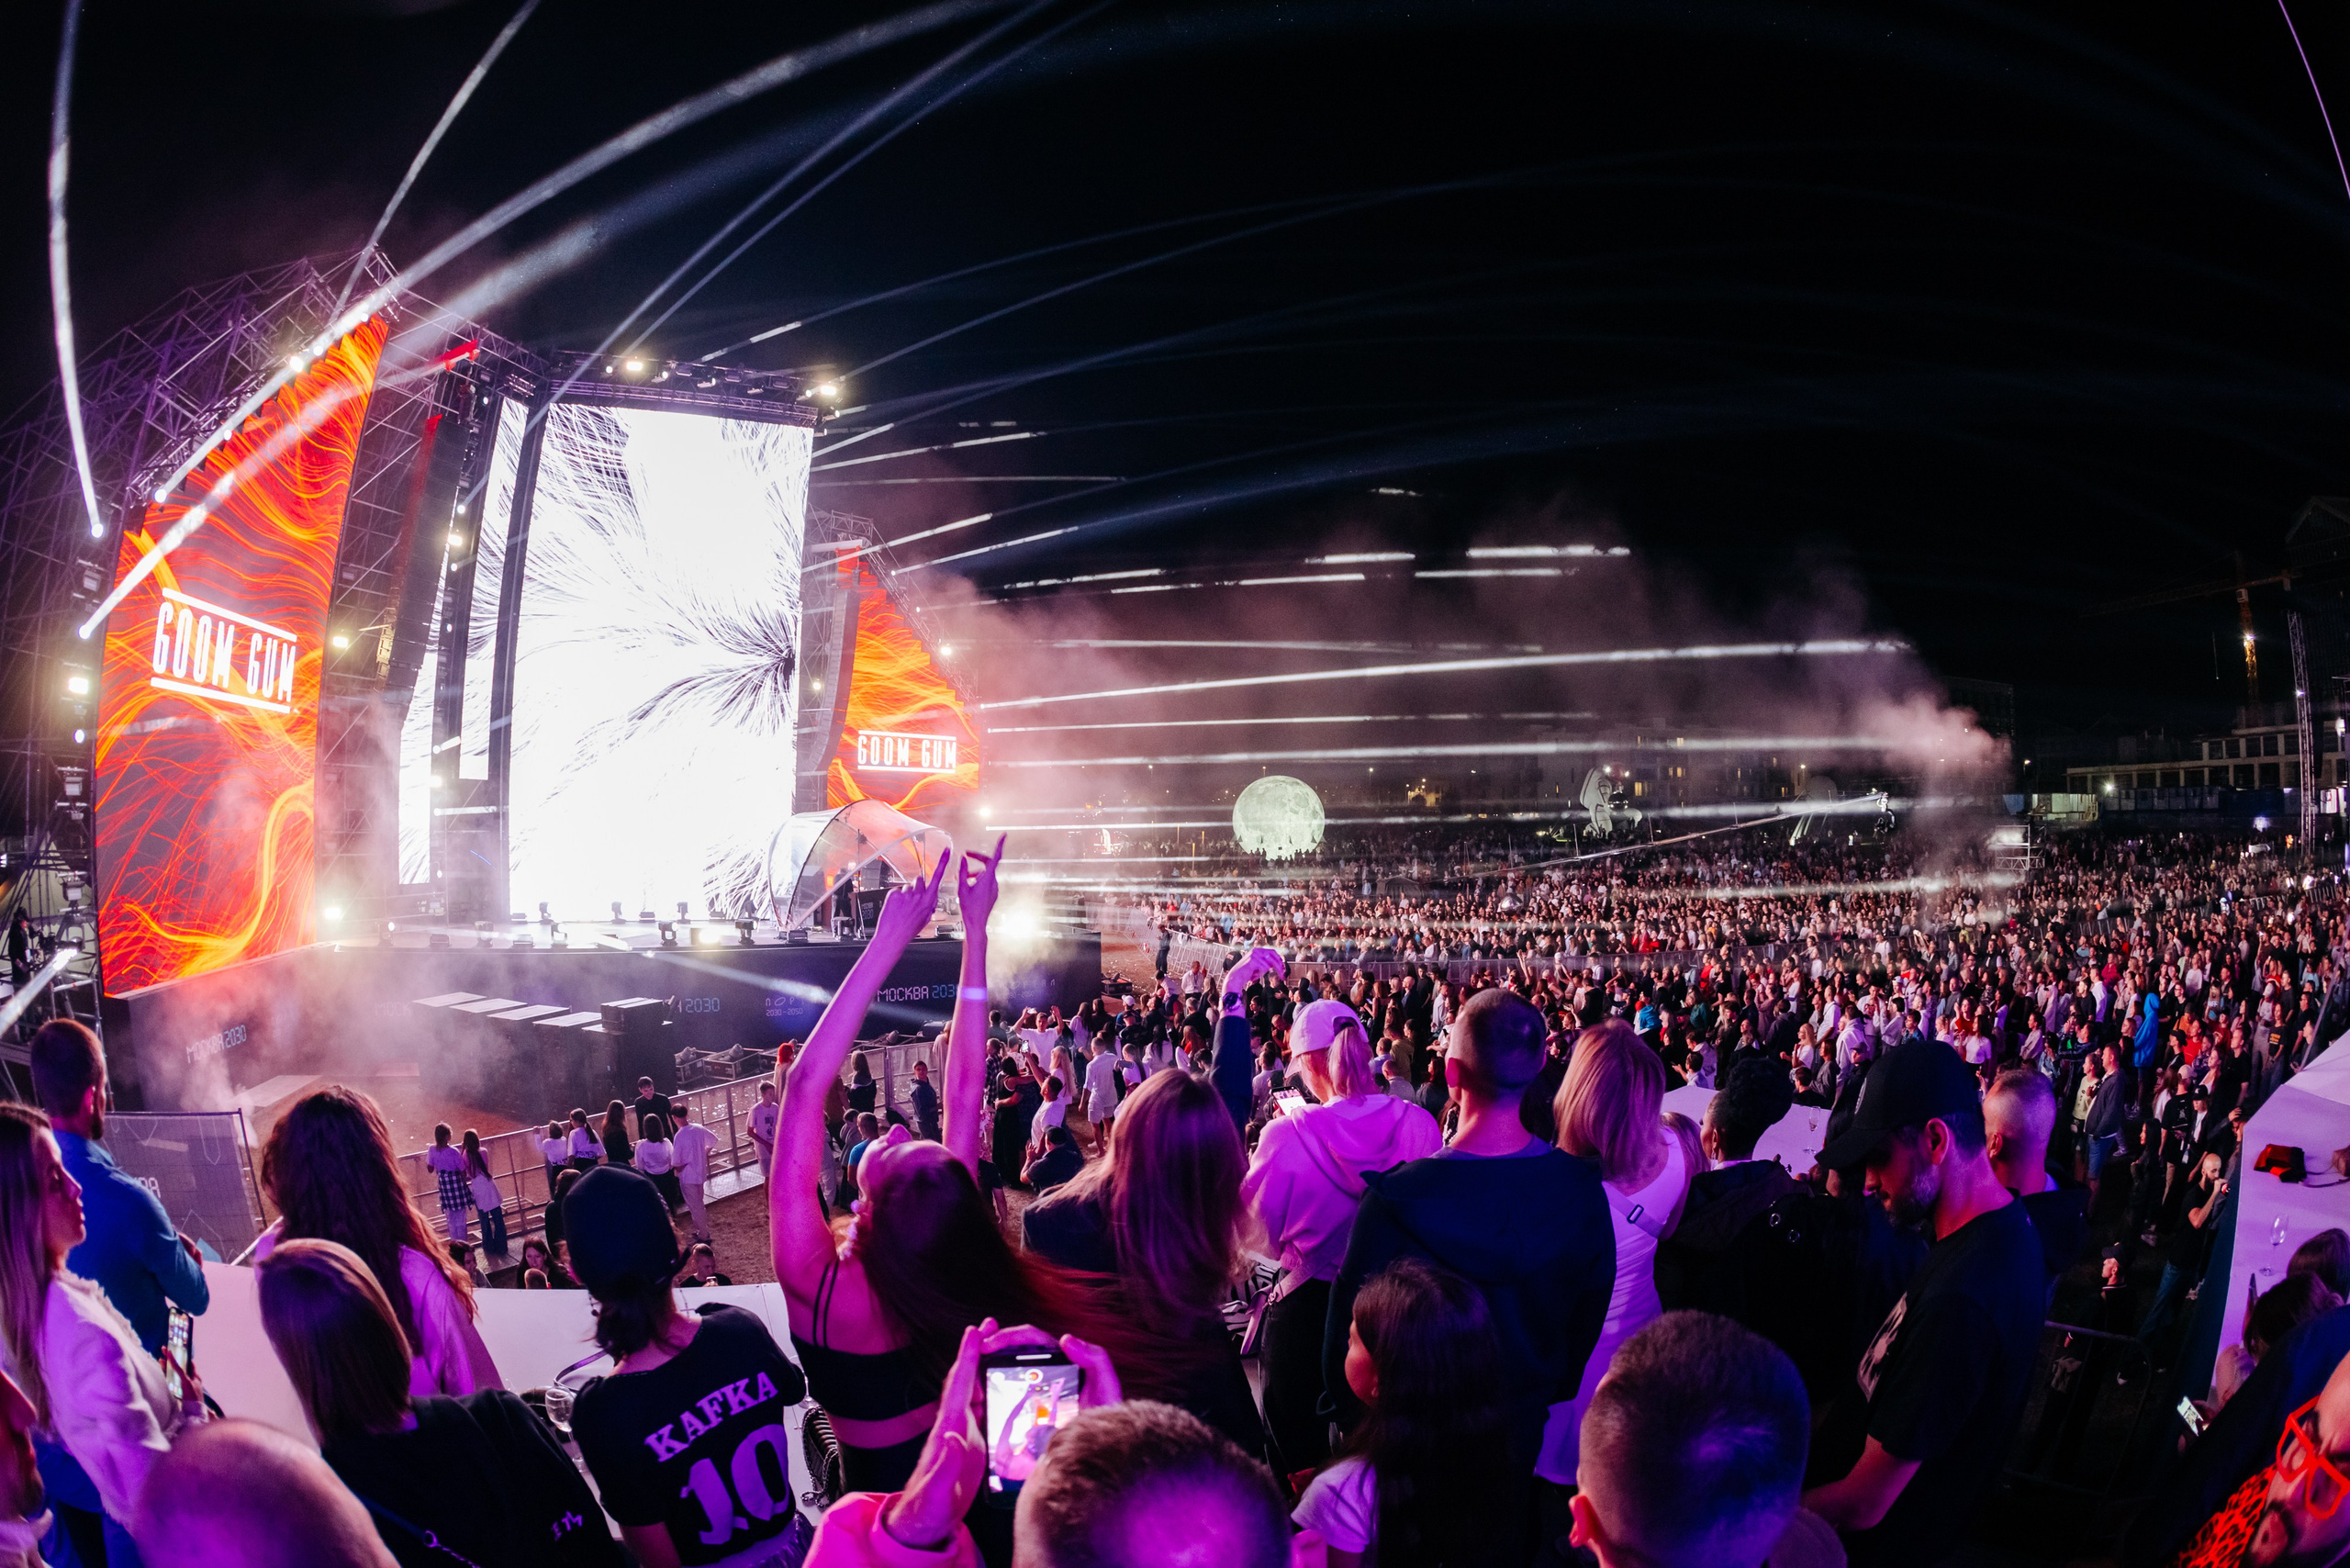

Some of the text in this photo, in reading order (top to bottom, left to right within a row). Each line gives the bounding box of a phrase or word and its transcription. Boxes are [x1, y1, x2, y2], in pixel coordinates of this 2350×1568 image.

[152, 601, 297, 702] GOOM GUM
[857, 735, 957, 769] GOOM GUM
[685, 997, 721, 1014] 2030
[877, 984, 958, 1002] МОСКВА 203
[185, 1025, 247, 1064] МОСКВА 2030
[644, 1372, 778, 1462] KAFKA
[679, 1423, 789, 1545] 10
